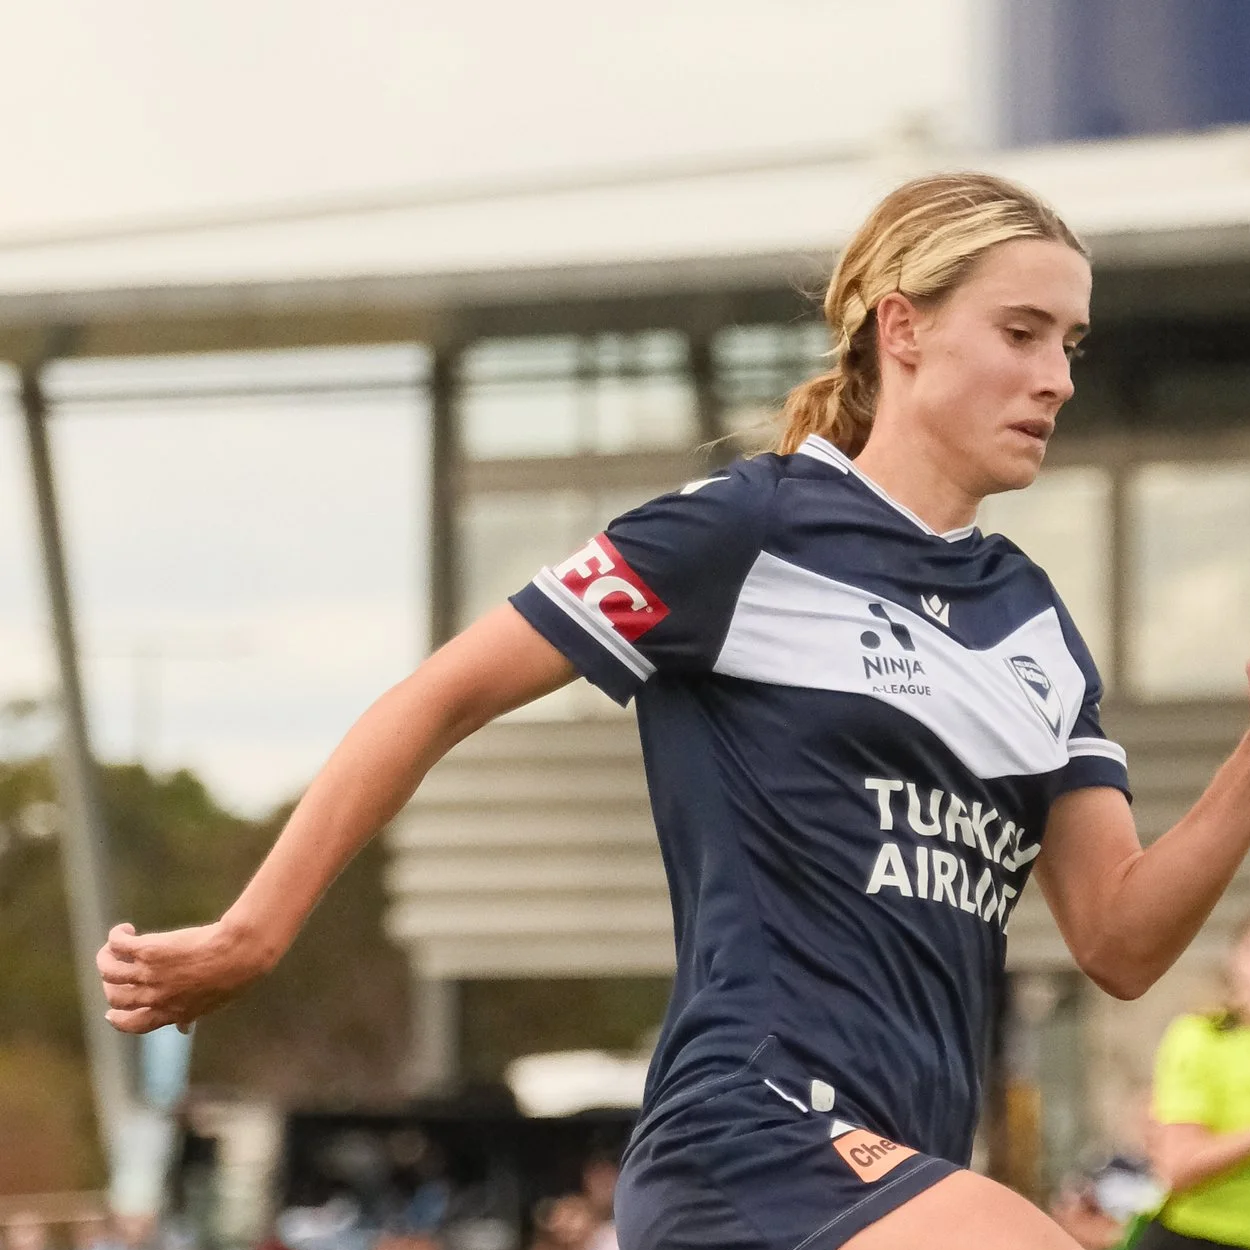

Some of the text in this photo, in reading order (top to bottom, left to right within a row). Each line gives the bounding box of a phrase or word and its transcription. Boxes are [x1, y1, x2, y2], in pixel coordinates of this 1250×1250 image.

[862, 655, 926, 681] NINJA
[872, 684, 932, 697] A-LEAGUE
[849, 1139, 898, 1168] Che
